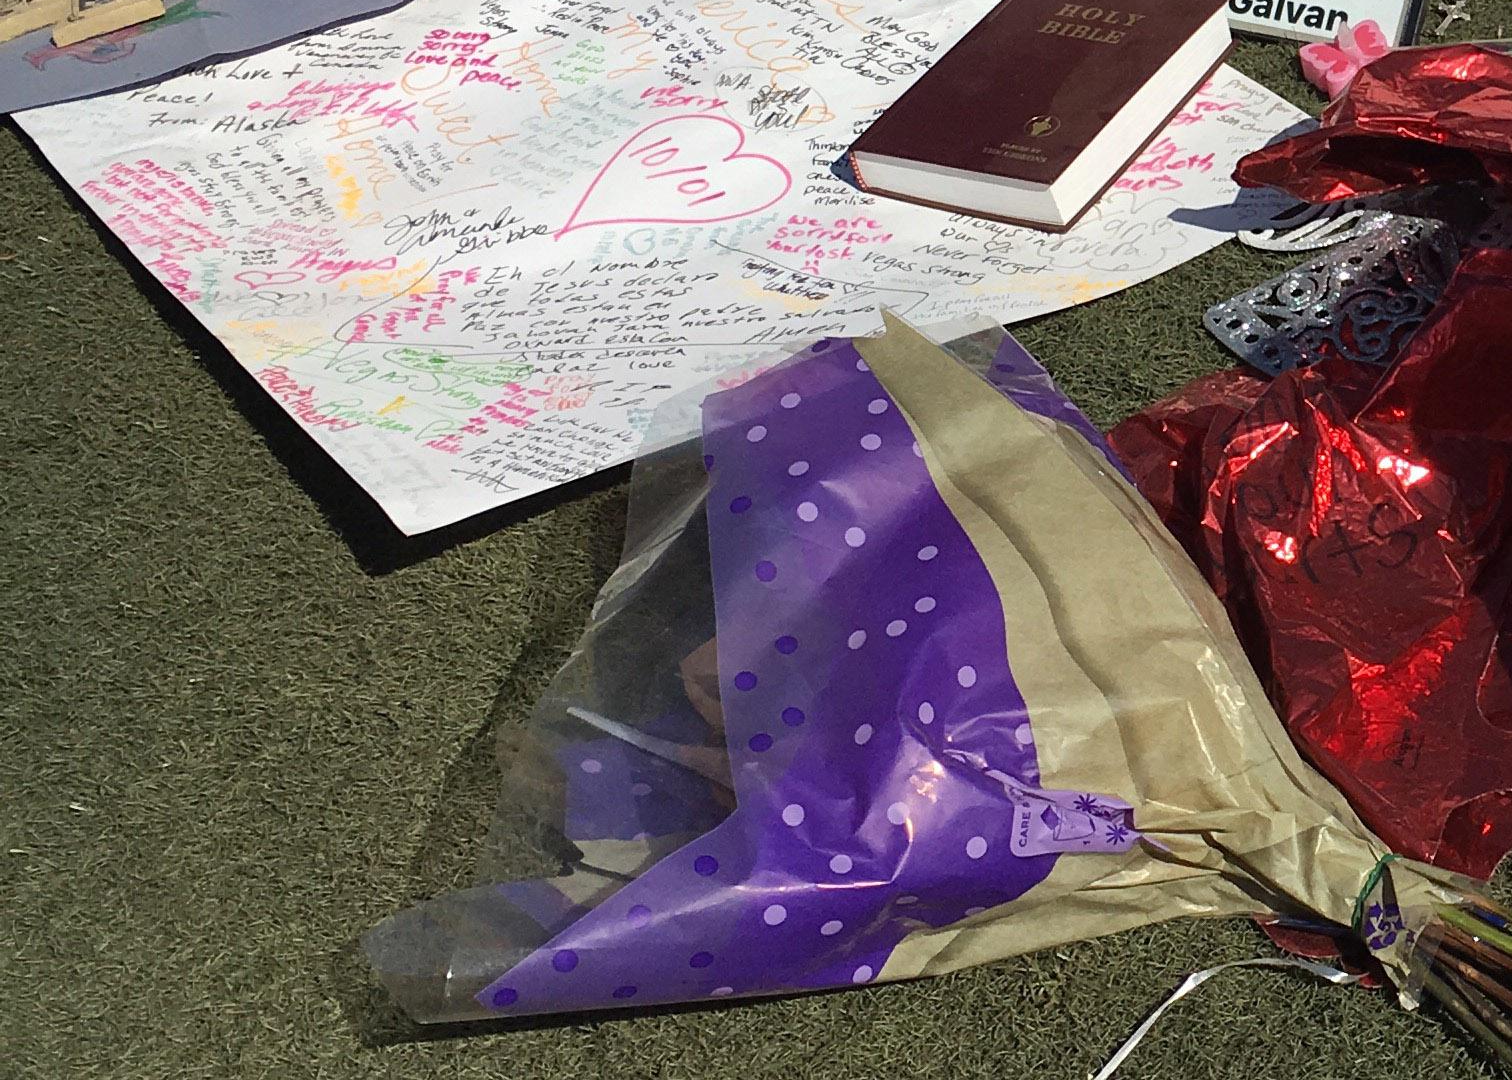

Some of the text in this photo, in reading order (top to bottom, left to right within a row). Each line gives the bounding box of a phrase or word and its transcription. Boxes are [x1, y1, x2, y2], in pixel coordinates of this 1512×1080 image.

[1054, 2, 1148, 28] HOLY
[1035, 19, 1128, 45] BIBLE
[1019, 812, 1031, 847] CARE
